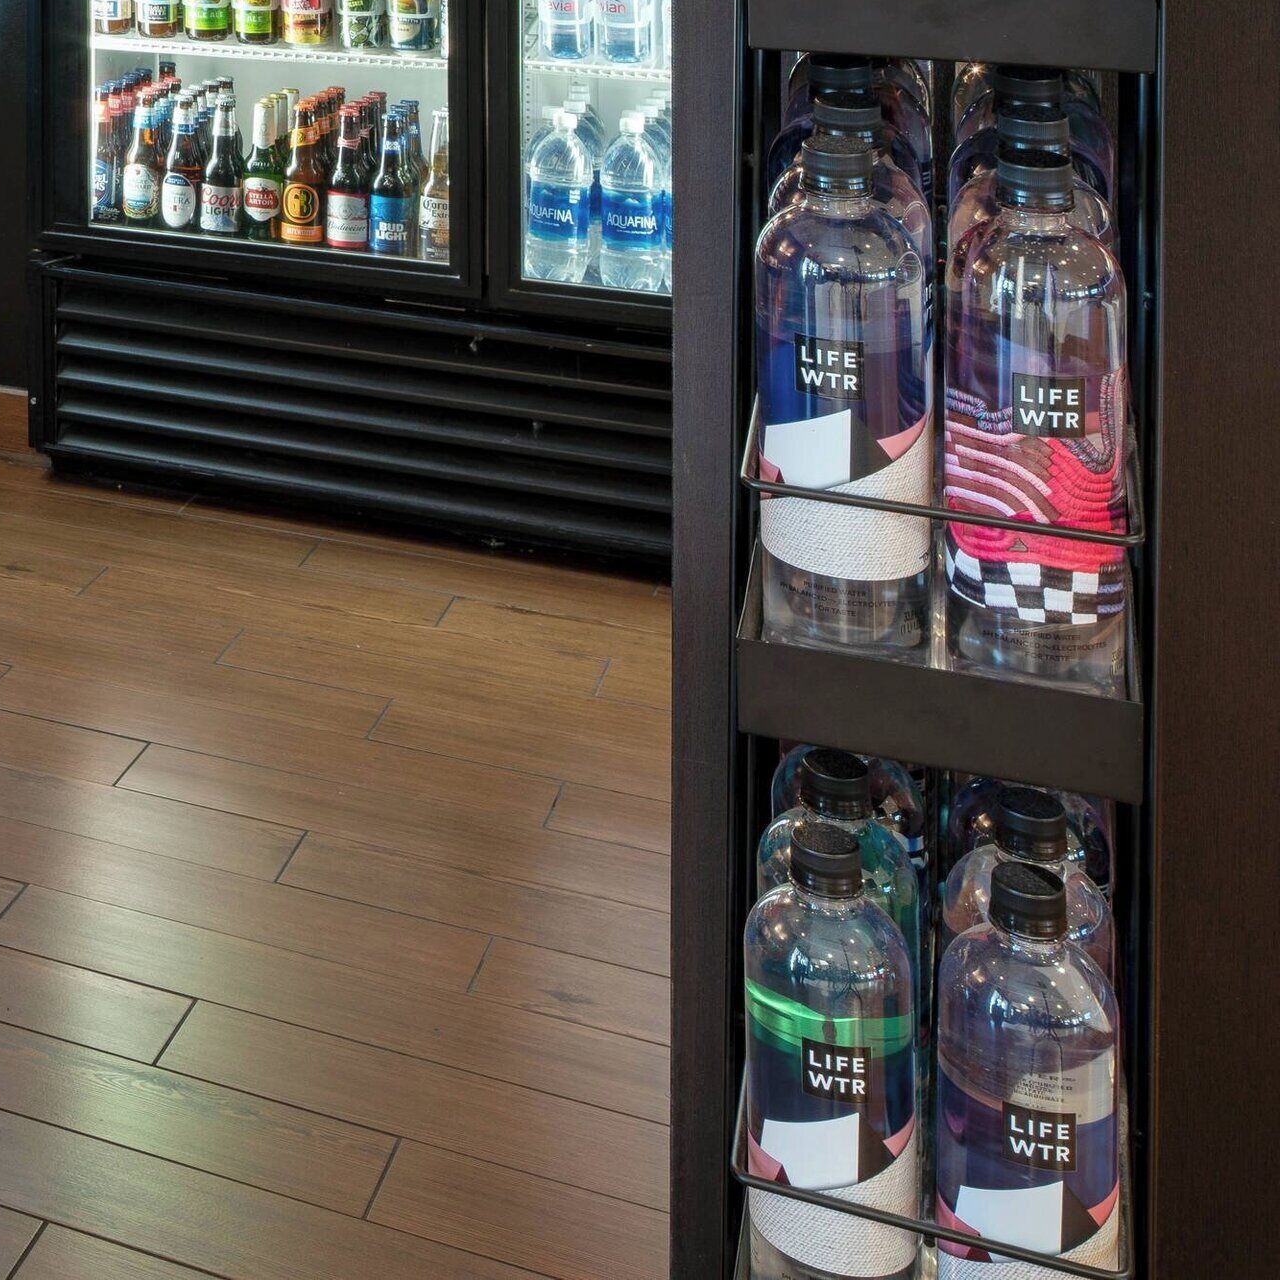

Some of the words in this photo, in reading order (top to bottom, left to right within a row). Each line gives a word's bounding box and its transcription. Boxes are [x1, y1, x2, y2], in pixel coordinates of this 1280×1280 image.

[249, 192, 274, 200] STELLA
[249, 198, 274, 206] ARTOIS
[206, 207, 236, 216] LIGHT
[422, 198, 449, 211] Coro
[378, 221, 404, 232] BUD
[607, 211, 658, 230] AQUAFINA
[375, 230, 408, 241] LIGHT
[801, 345, 857, 369] LIFE
[801, 368, 858, 391] WTR
[1020, 385, 1080, 406] LIFE
[1019, 410, 1080, 429] WTR
[803, 580, 838, 594] PURIFIED
[830, 606, 857, 617] TASTE
[1053, 633, 1081, 641] WATER
[809, 1049, 865, 1074] LIFE
[809, 1072, 866, 1095] WTR
[1010, 1114, 1070, 1140] LIFE
[1009, 1136, 1071, 1163] WTR
